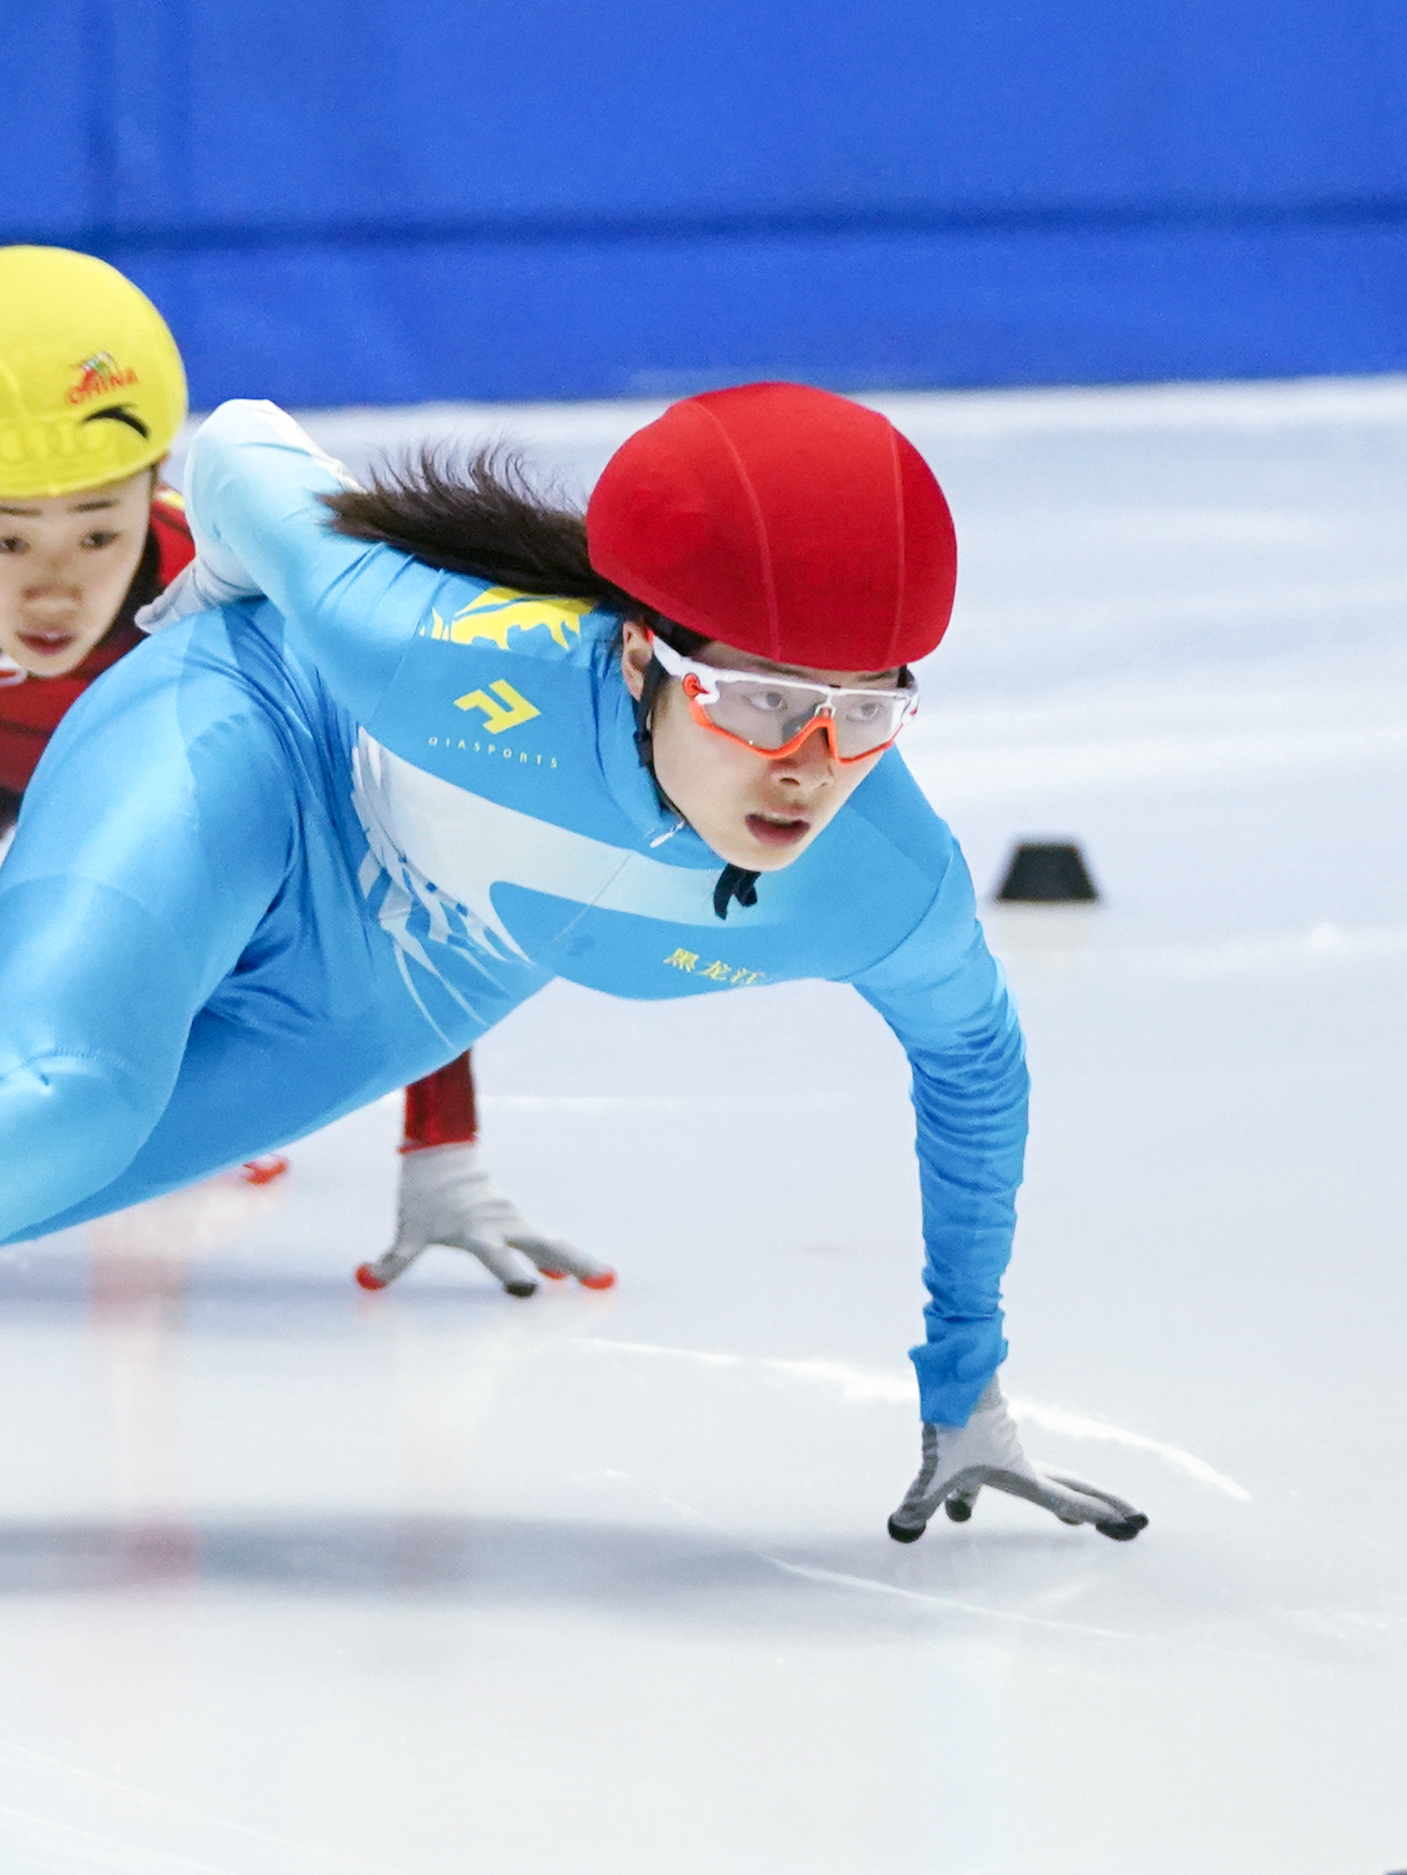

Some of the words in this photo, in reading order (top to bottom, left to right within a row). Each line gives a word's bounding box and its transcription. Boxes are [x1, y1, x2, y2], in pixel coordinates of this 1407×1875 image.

[67, 366, 138, 405] CHINA
[663, 946, 766, 985] 黑龙江
